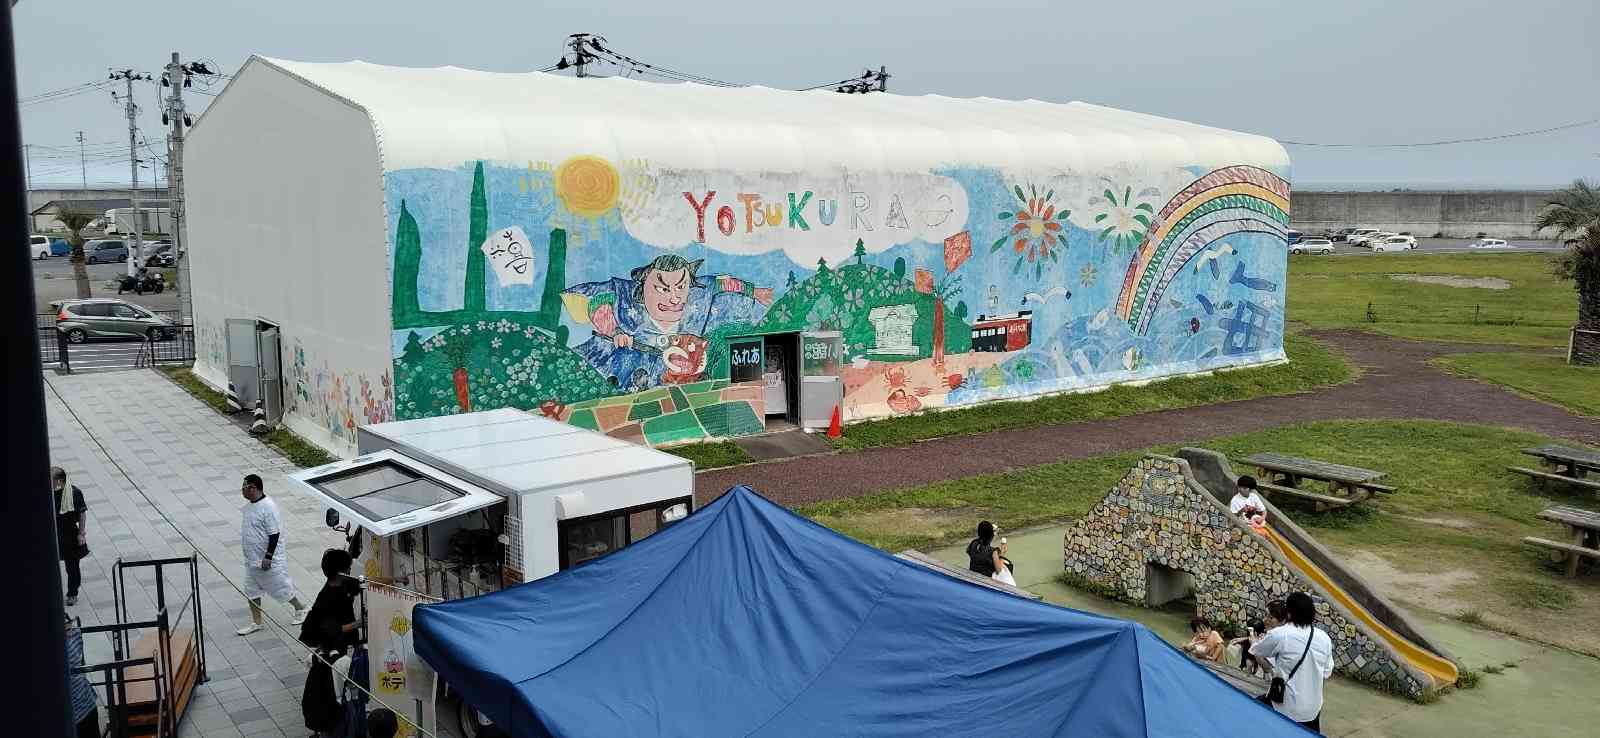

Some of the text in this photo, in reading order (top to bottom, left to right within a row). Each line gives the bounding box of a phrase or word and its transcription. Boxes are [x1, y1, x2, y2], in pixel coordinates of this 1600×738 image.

[682, 190, 911, 243] YOTSUKURA
[731, 346, 760, 366] ふれあ
